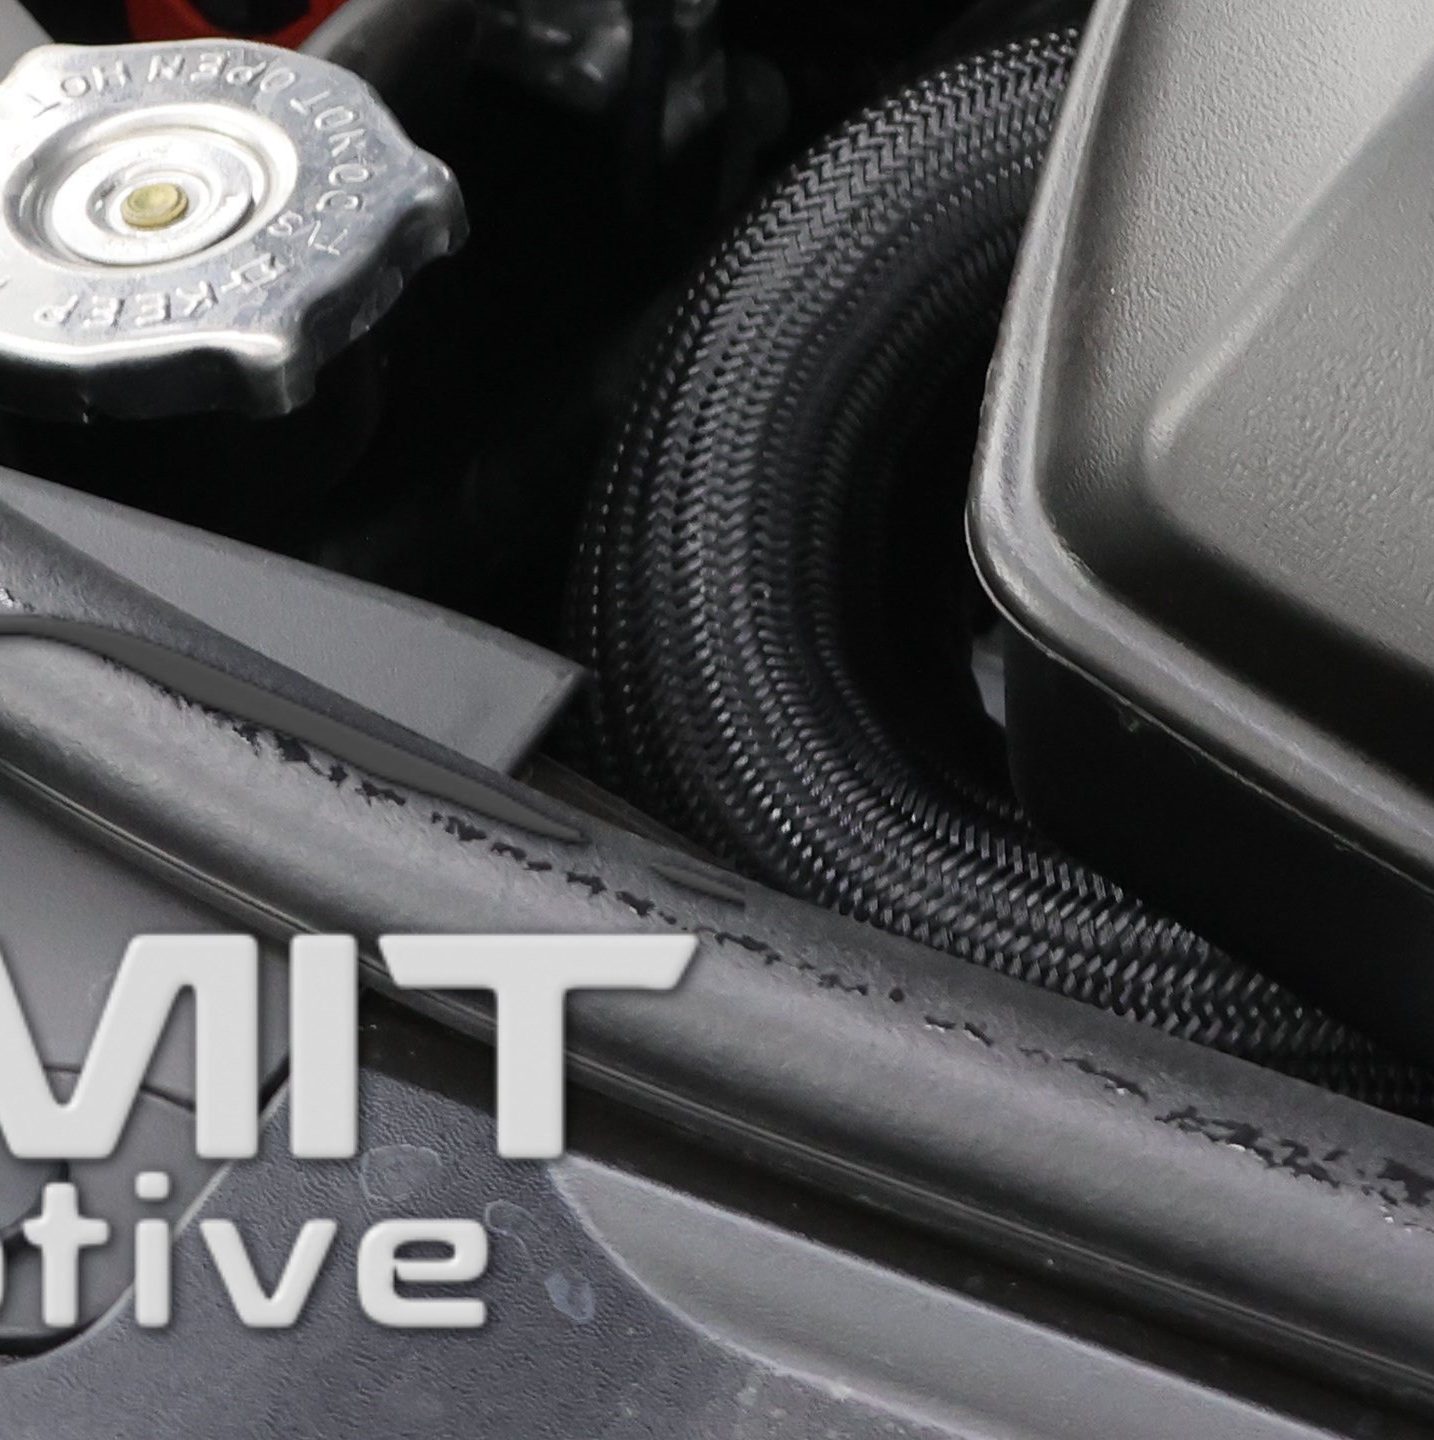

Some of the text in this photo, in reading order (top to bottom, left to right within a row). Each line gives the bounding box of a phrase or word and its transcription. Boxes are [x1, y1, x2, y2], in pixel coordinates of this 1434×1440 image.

[25, 51, 374, 215] DO NOT OPEN HOT
[32, 276, 220, 330] KEEP
